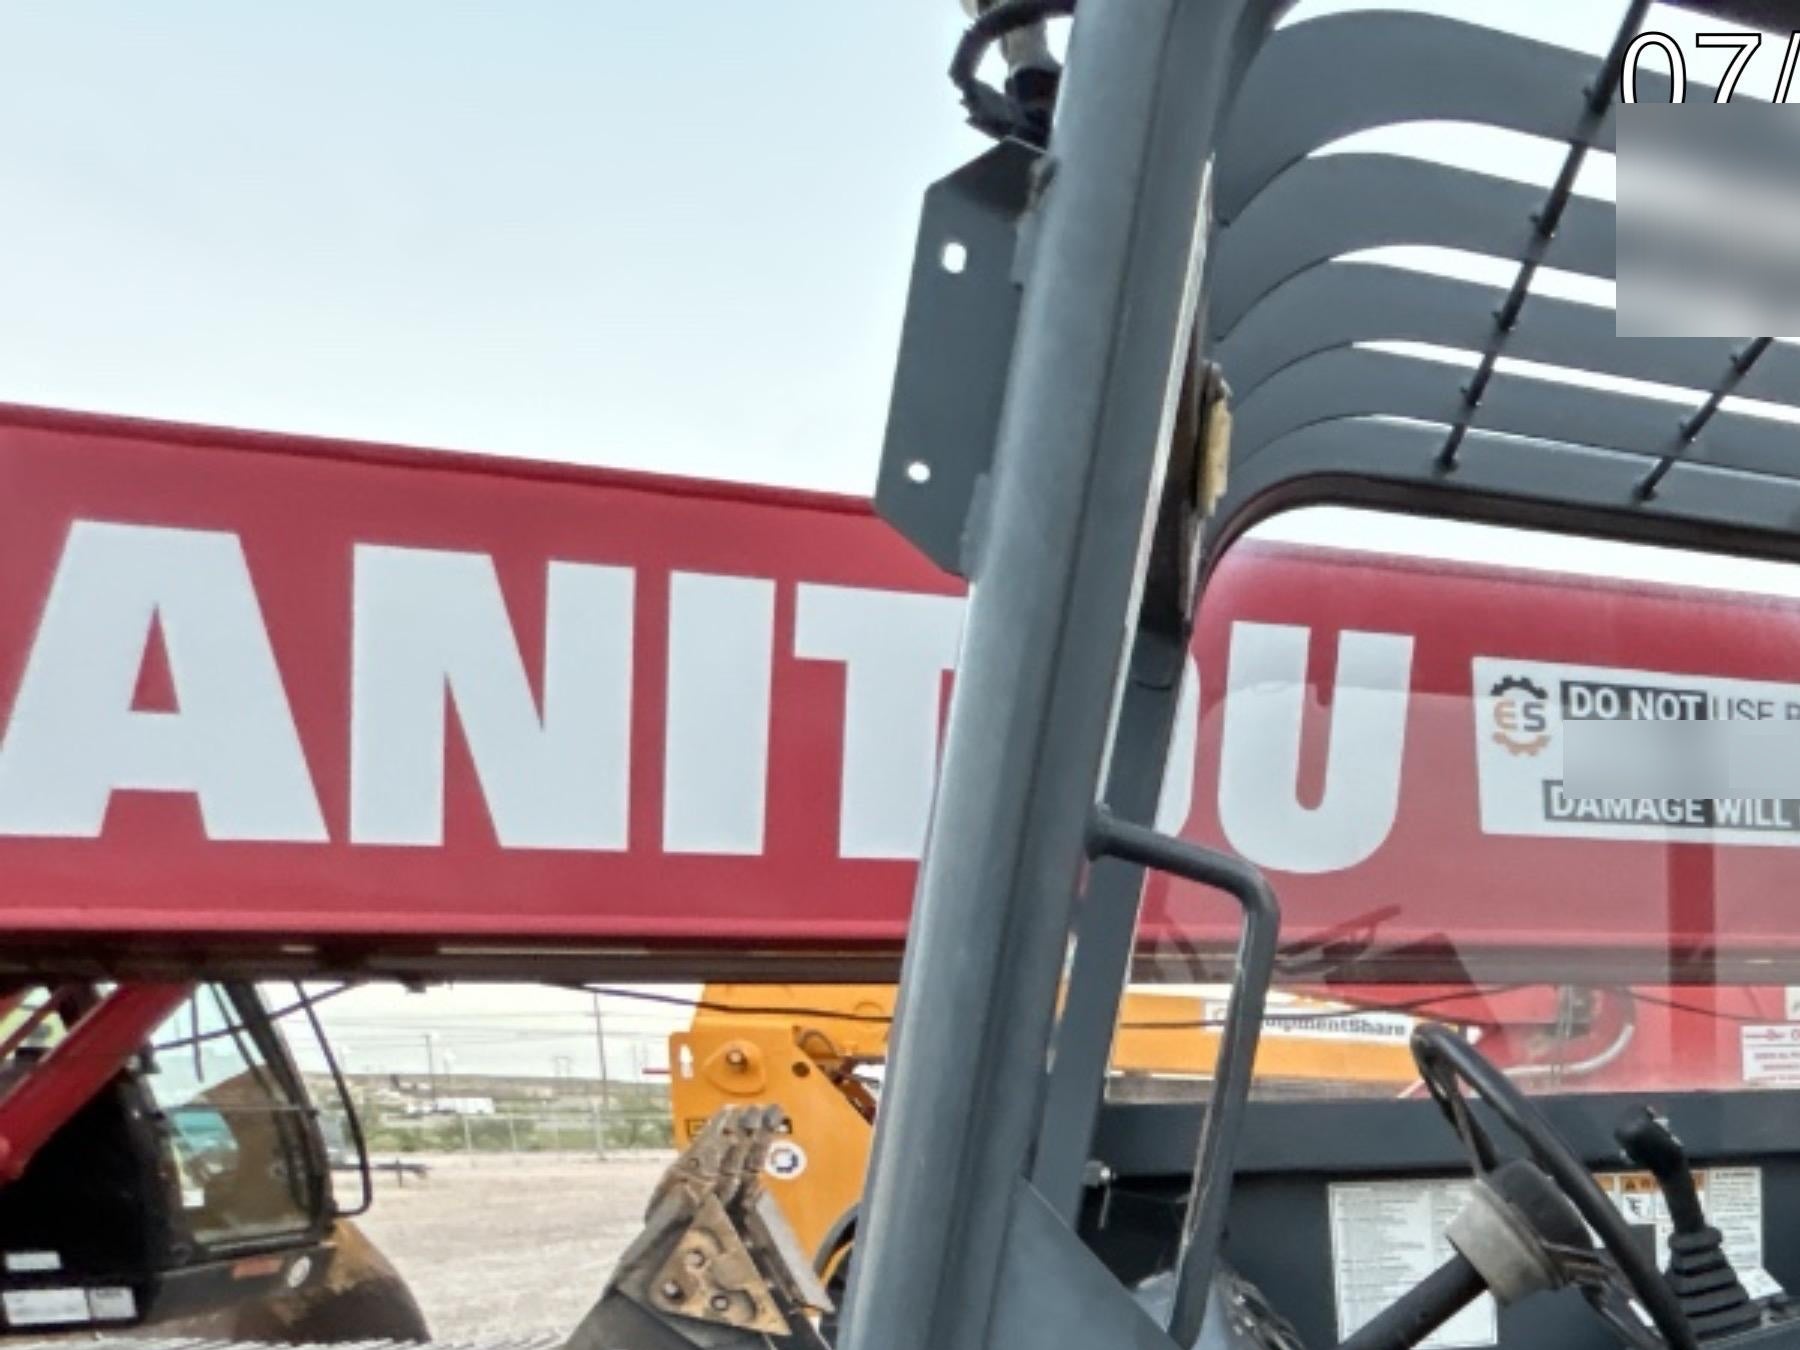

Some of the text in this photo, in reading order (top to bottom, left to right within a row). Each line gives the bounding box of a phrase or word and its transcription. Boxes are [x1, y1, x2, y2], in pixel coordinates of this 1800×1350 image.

[0, 519, 1413, 874] ANITU
[1568, 685, 1620, 720] DO
[1631, 693, 1704, 720] NOT
[1551, 785, 1704, 823] DAMAGE
[1712, 798, 1791, 828] WILL
